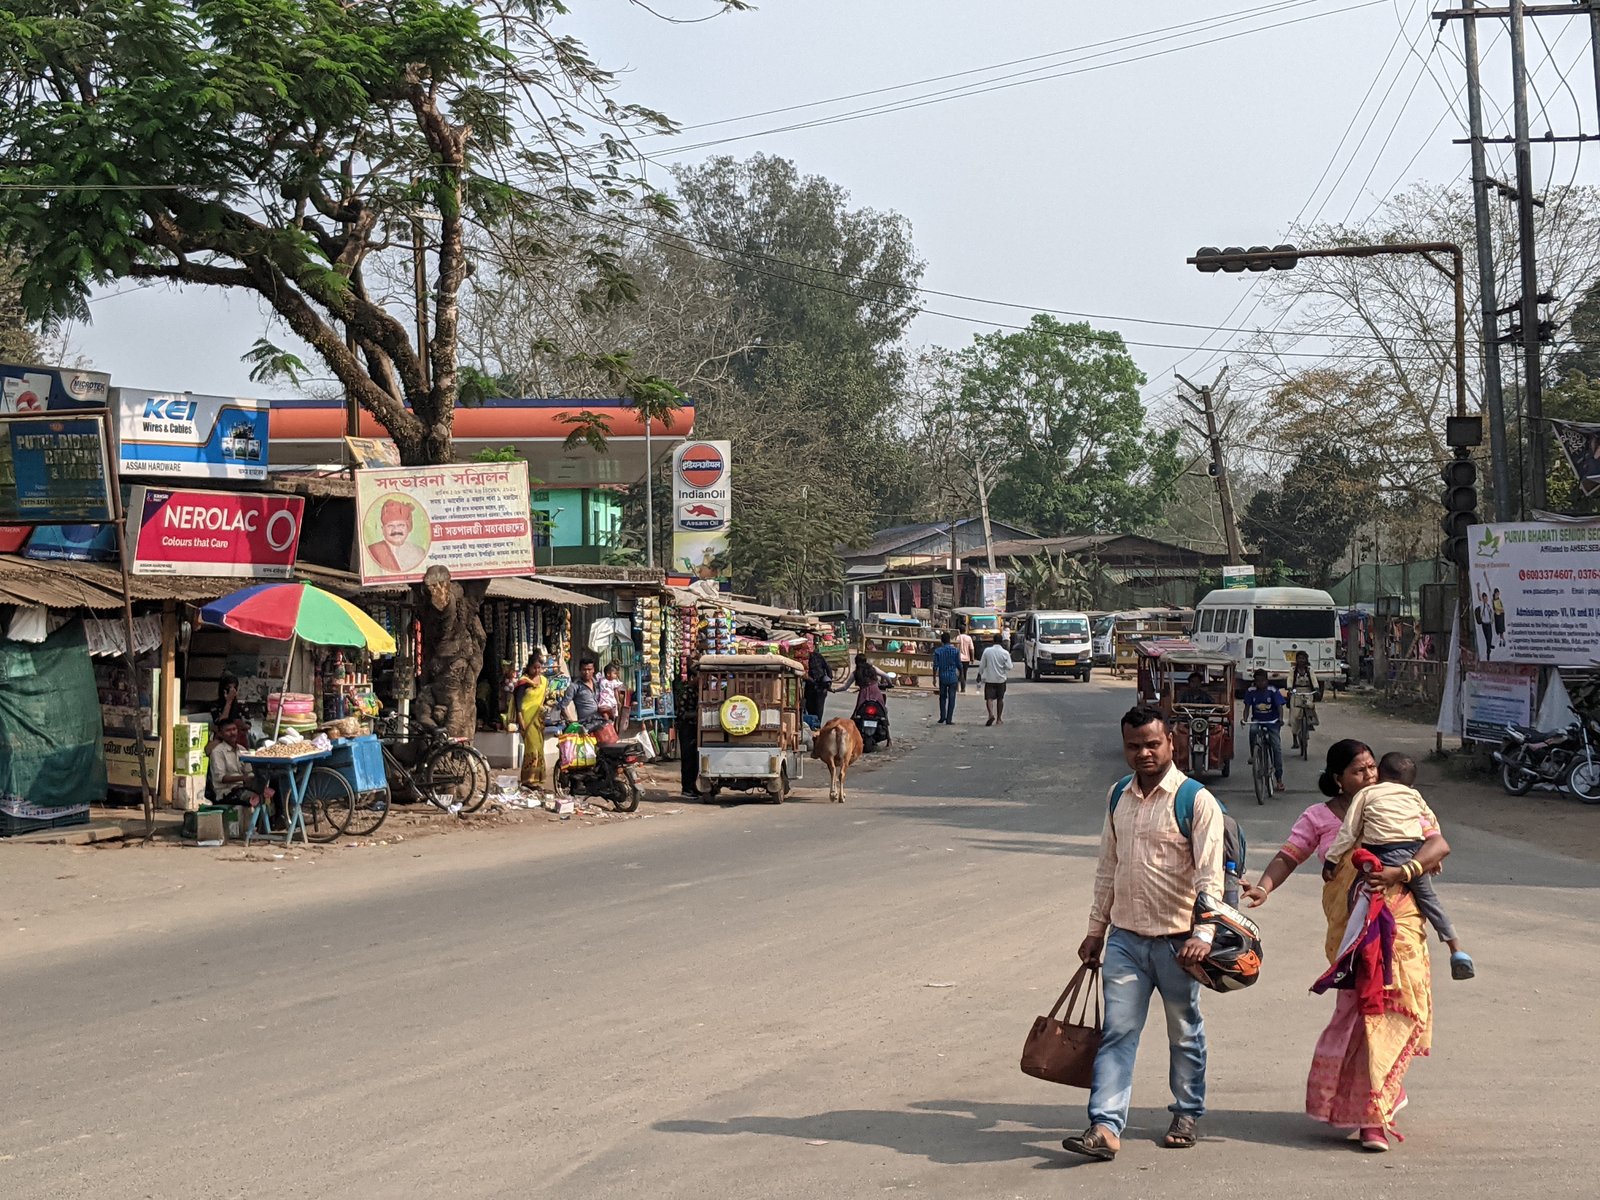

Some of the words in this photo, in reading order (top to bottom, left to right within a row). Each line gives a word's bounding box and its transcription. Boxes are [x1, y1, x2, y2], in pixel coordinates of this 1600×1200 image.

[143, 398, 198, 421] KEI
[143, 422, 163, 433] Wires
[164, 424, 169, 433] &
[170, 423, 192, 434] Cables
[126, 462, 147, 470] ASSAM
[148, 462, 181, 472] HARDWARE
[678, 490, 725, 499] IndianOil
[164, 505, 259, 532] NEROLAC
[162, 536, 192, 547] Colours
[194, 537, 209, 548] that
[211, 538, 229, 548] Care
[1504, 531, 1526, 544] PURVA
[1528, 529, 1558, 543] BHARATI
[1526, 570, 1576, 581] 6003374607,
[1578, 570, 1600, 580] 0376-
[1577, 608, 1587, 616] and
[880, 658, 906, 668] ASSAM
[912, 660, 934, 669] POLIC
